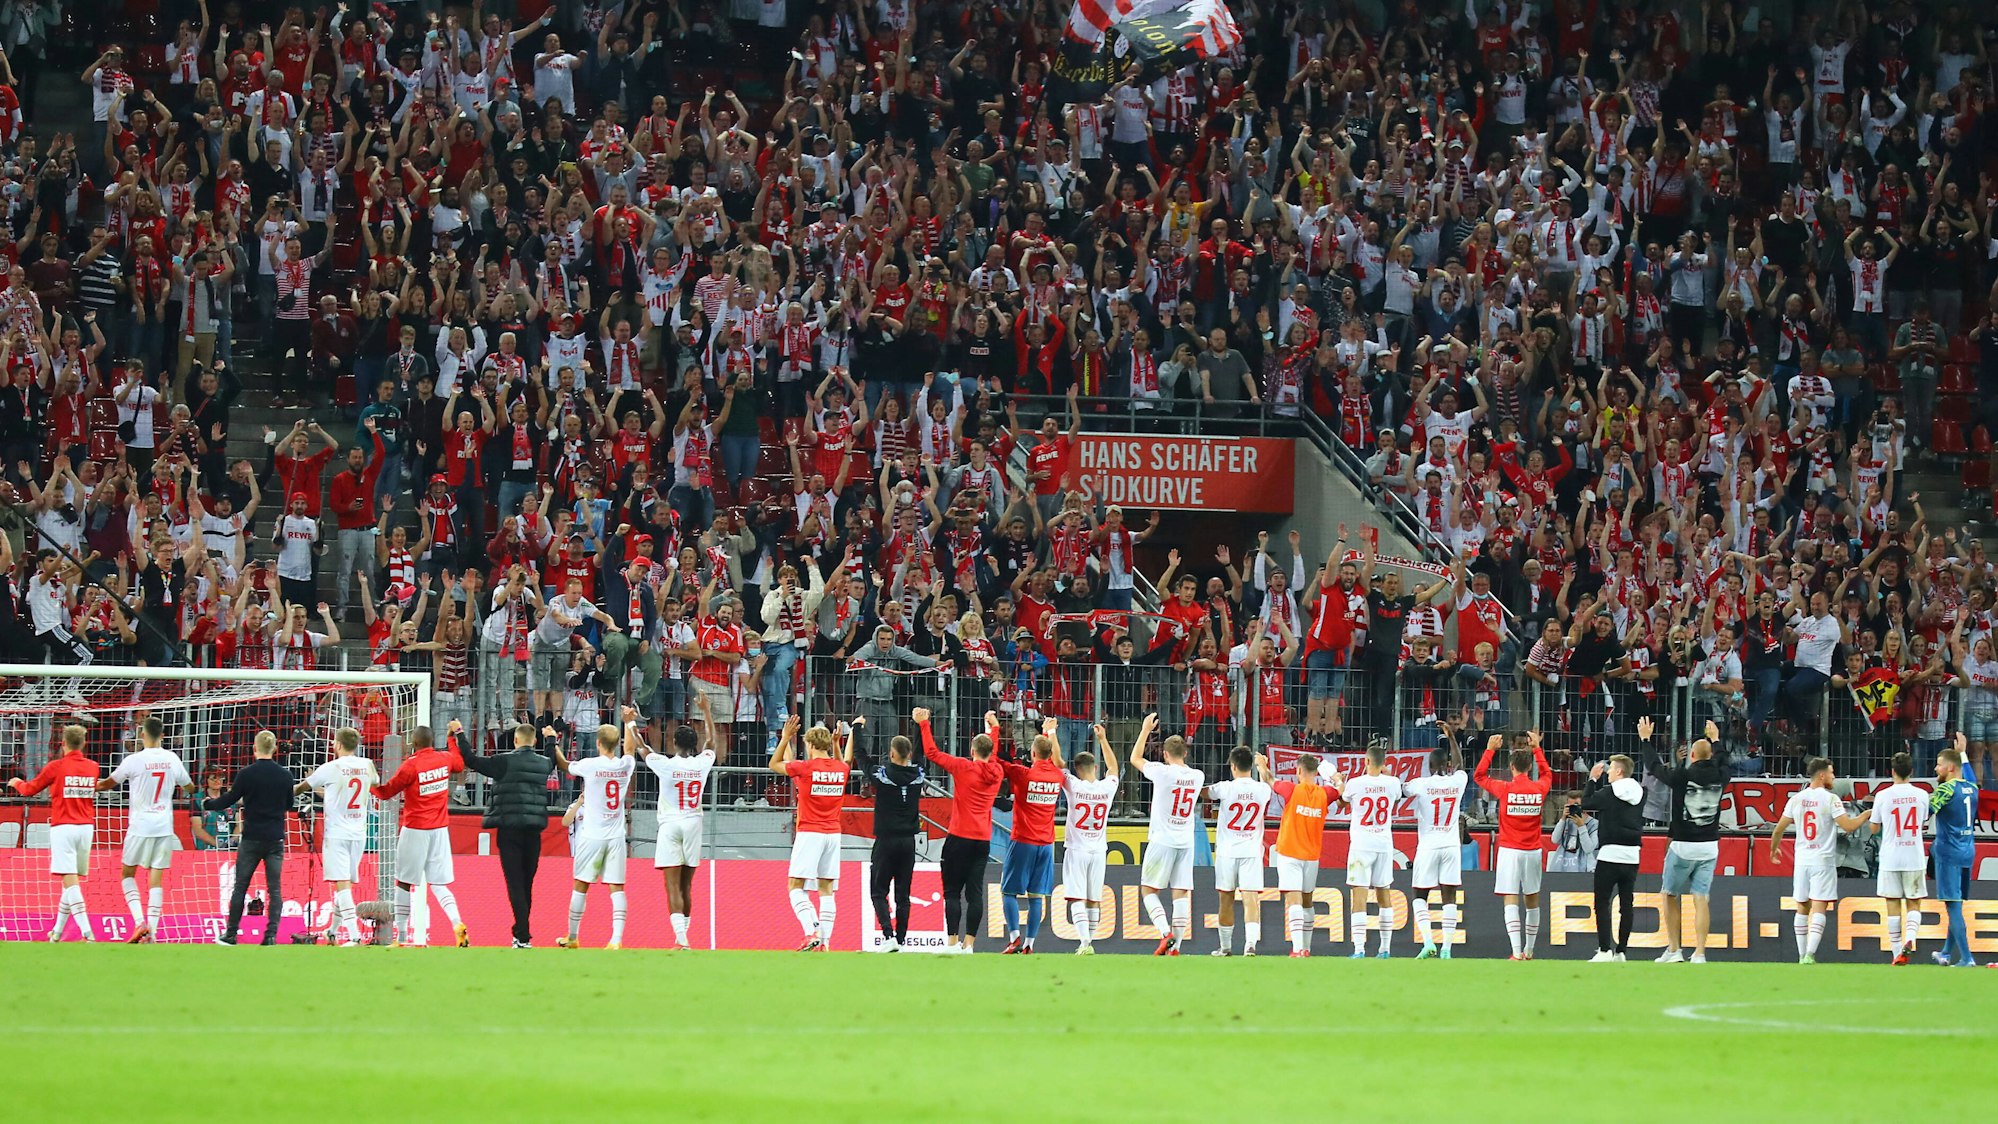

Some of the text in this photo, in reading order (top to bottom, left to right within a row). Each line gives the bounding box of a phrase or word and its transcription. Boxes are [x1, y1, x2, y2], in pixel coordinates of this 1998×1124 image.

[466, 86, 485, 95] REWE
[1122, 101, 1144, 110] REWE
[1347, 126, 1369, 137] REWE
[885, 298, 906, 306] REWE
[969, 347, 989, 355] REWE
[624, 444, 645, 453] REWE
[824, 442, 845, 450] REWE
[1035, 450, 1059, 463] REWE
[1080, 439, 1258, 473] HANS SCHÄFER
[1857, 474, 1878, 483] REWE
[1079, 470, 1204, 505] SÜDKURVE
[288, 531, 313, 540] REWE
[1356, 551, 1445, 575] DUBLESIEGER
[567, 568, 589, 576] REWE
[659, 636, 681, 648] REWE
[342, 768, 368, 776] SCHMITZ
[418, 766, 449, 783] REWE
[595, 770, 628, 778] ANDERSSON
[672, 771, 702, 779] EHIZIBUE
[1336, 755, 1424, 783] EUOPA
[65, 776, 95, 786] REWE
[812, 771, 844, 783] REWE
[152, 771, 165, 804] 7
[420, 781, 449, 794] uhlsport
[812, 785, 843, 795] uhlsport
[1028, 781, 1060, 793] REWE
[1365, 786, 1386, 794] SKHIRI
[347, 778, 362, 810] 2
[605, 780, 620, 811] 9
[674, 780, 701, 811] 19
[1075, 791, 1109, 801] THIELMANN
[1507, 793, 1542, 804] REWE
[1171, 788, 1196, 818] 15
[1892, 796, 1917, 805] HECTOR
[1295, 805, 1322, 818] REWE
[1359, 796, 1390, 826] 28
[1431, 797, 1456, 827] 17
[1508, 805, 1541, 815] uhlsport
[1963, 795, 1971, 827] 1
[1075, 803, 1107, 831] 29
[1227, 803, 1260, 831] 22
[1891, 806, 1919, 837] 14
[1803, 810, 1817, 841] 6
[874, 937, 945, 947] BDESLIGA
